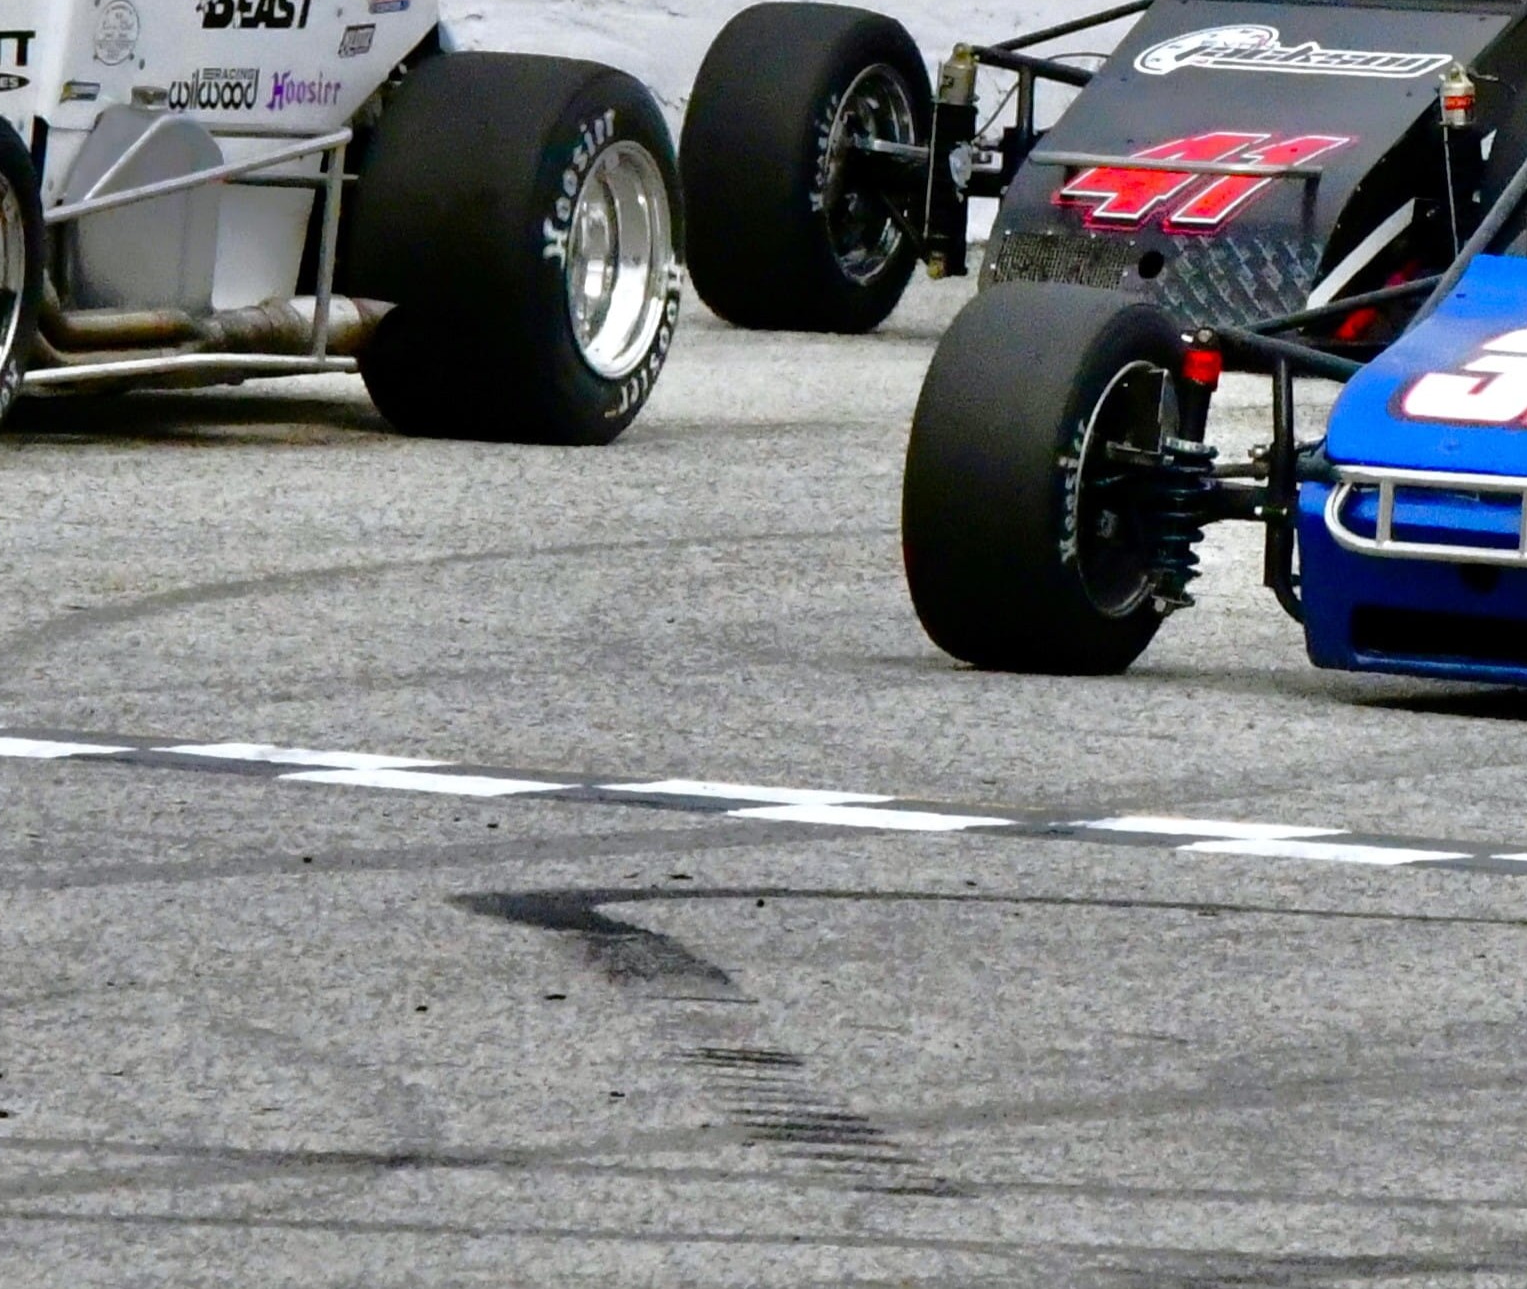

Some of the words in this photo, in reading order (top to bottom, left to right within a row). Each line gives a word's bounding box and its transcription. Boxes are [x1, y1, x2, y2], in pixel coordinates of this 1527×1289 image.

[168, 68, 260, 110] wilwood
[213, 68, 256, 80] RACING
[1053, 130, 1356, 231] 41
